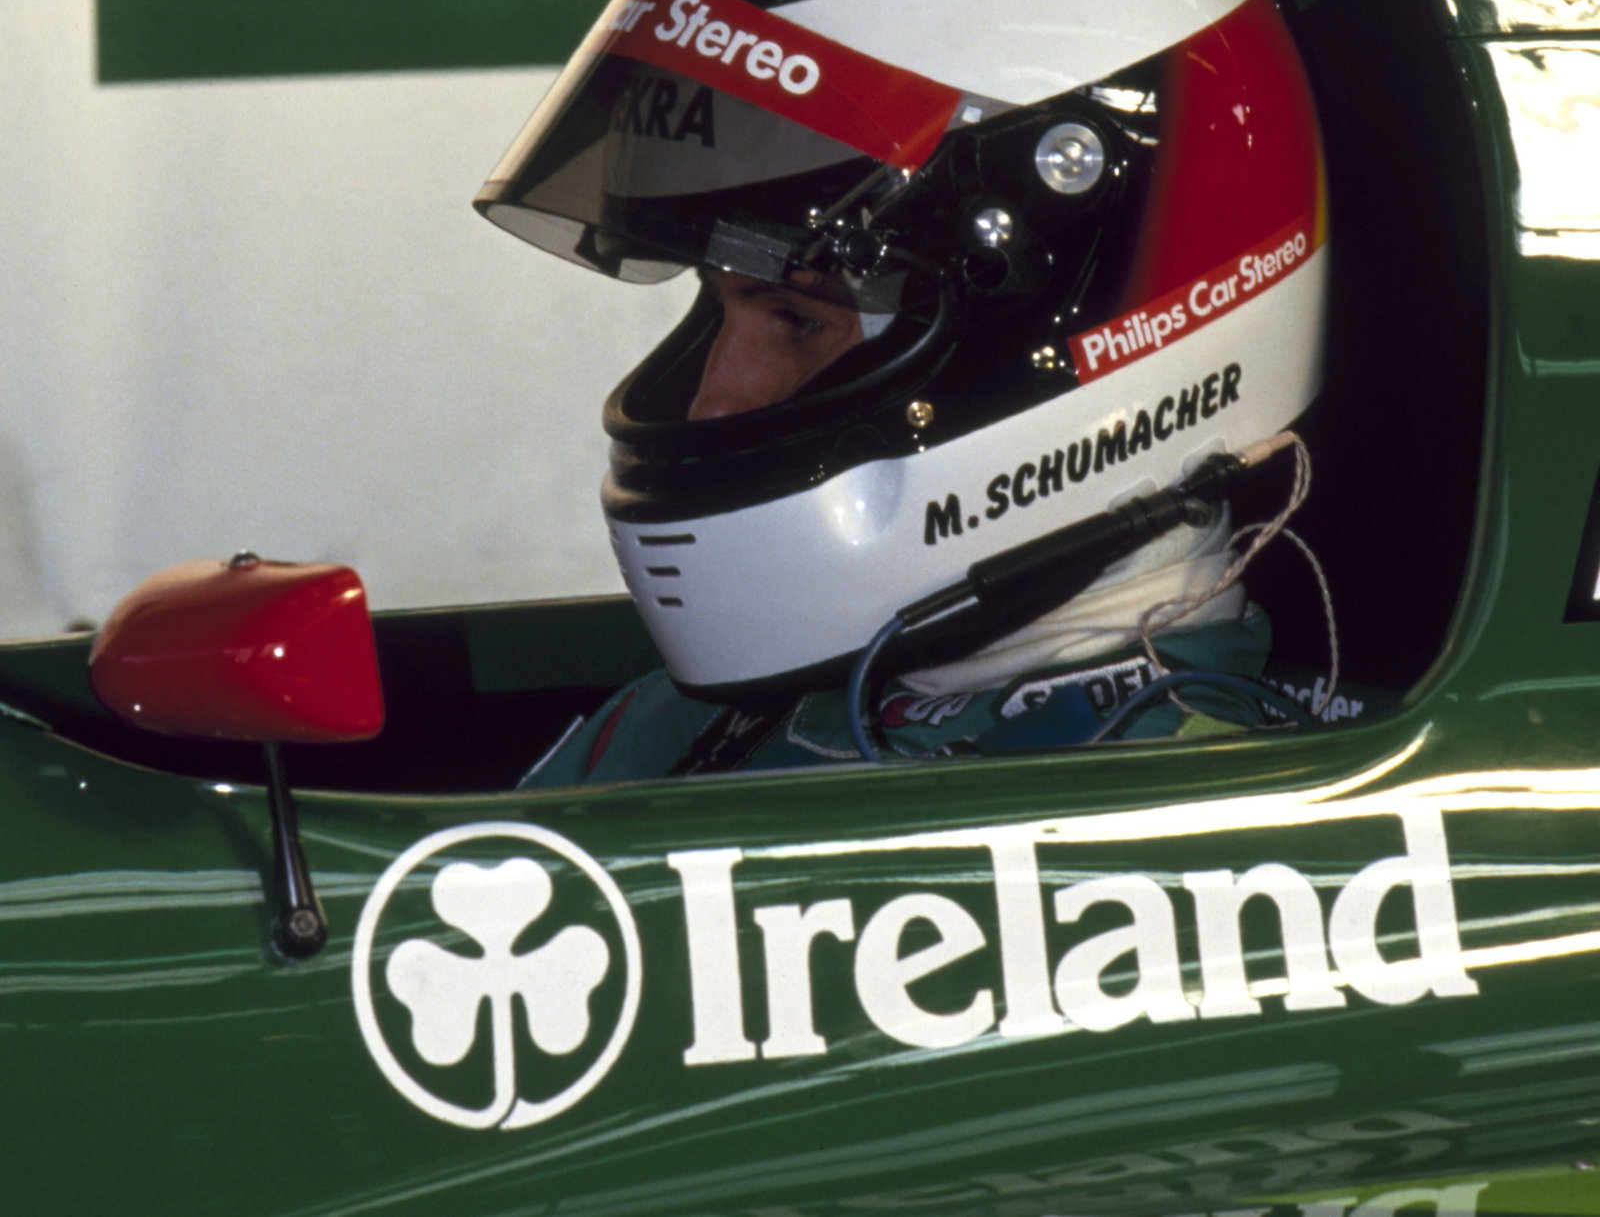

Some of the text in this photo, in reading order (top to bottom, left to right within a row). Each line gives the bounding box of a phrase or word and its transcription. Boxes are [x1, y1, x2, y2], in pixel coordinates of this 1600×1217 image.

[608, 0, 656, 33] ar
[1080, 231, 1307, 371] Philips Car Stereo
[923, 362, 1244, 546] M. SCHUMACHER
[667, 805, 1479, 1066] Ireland
